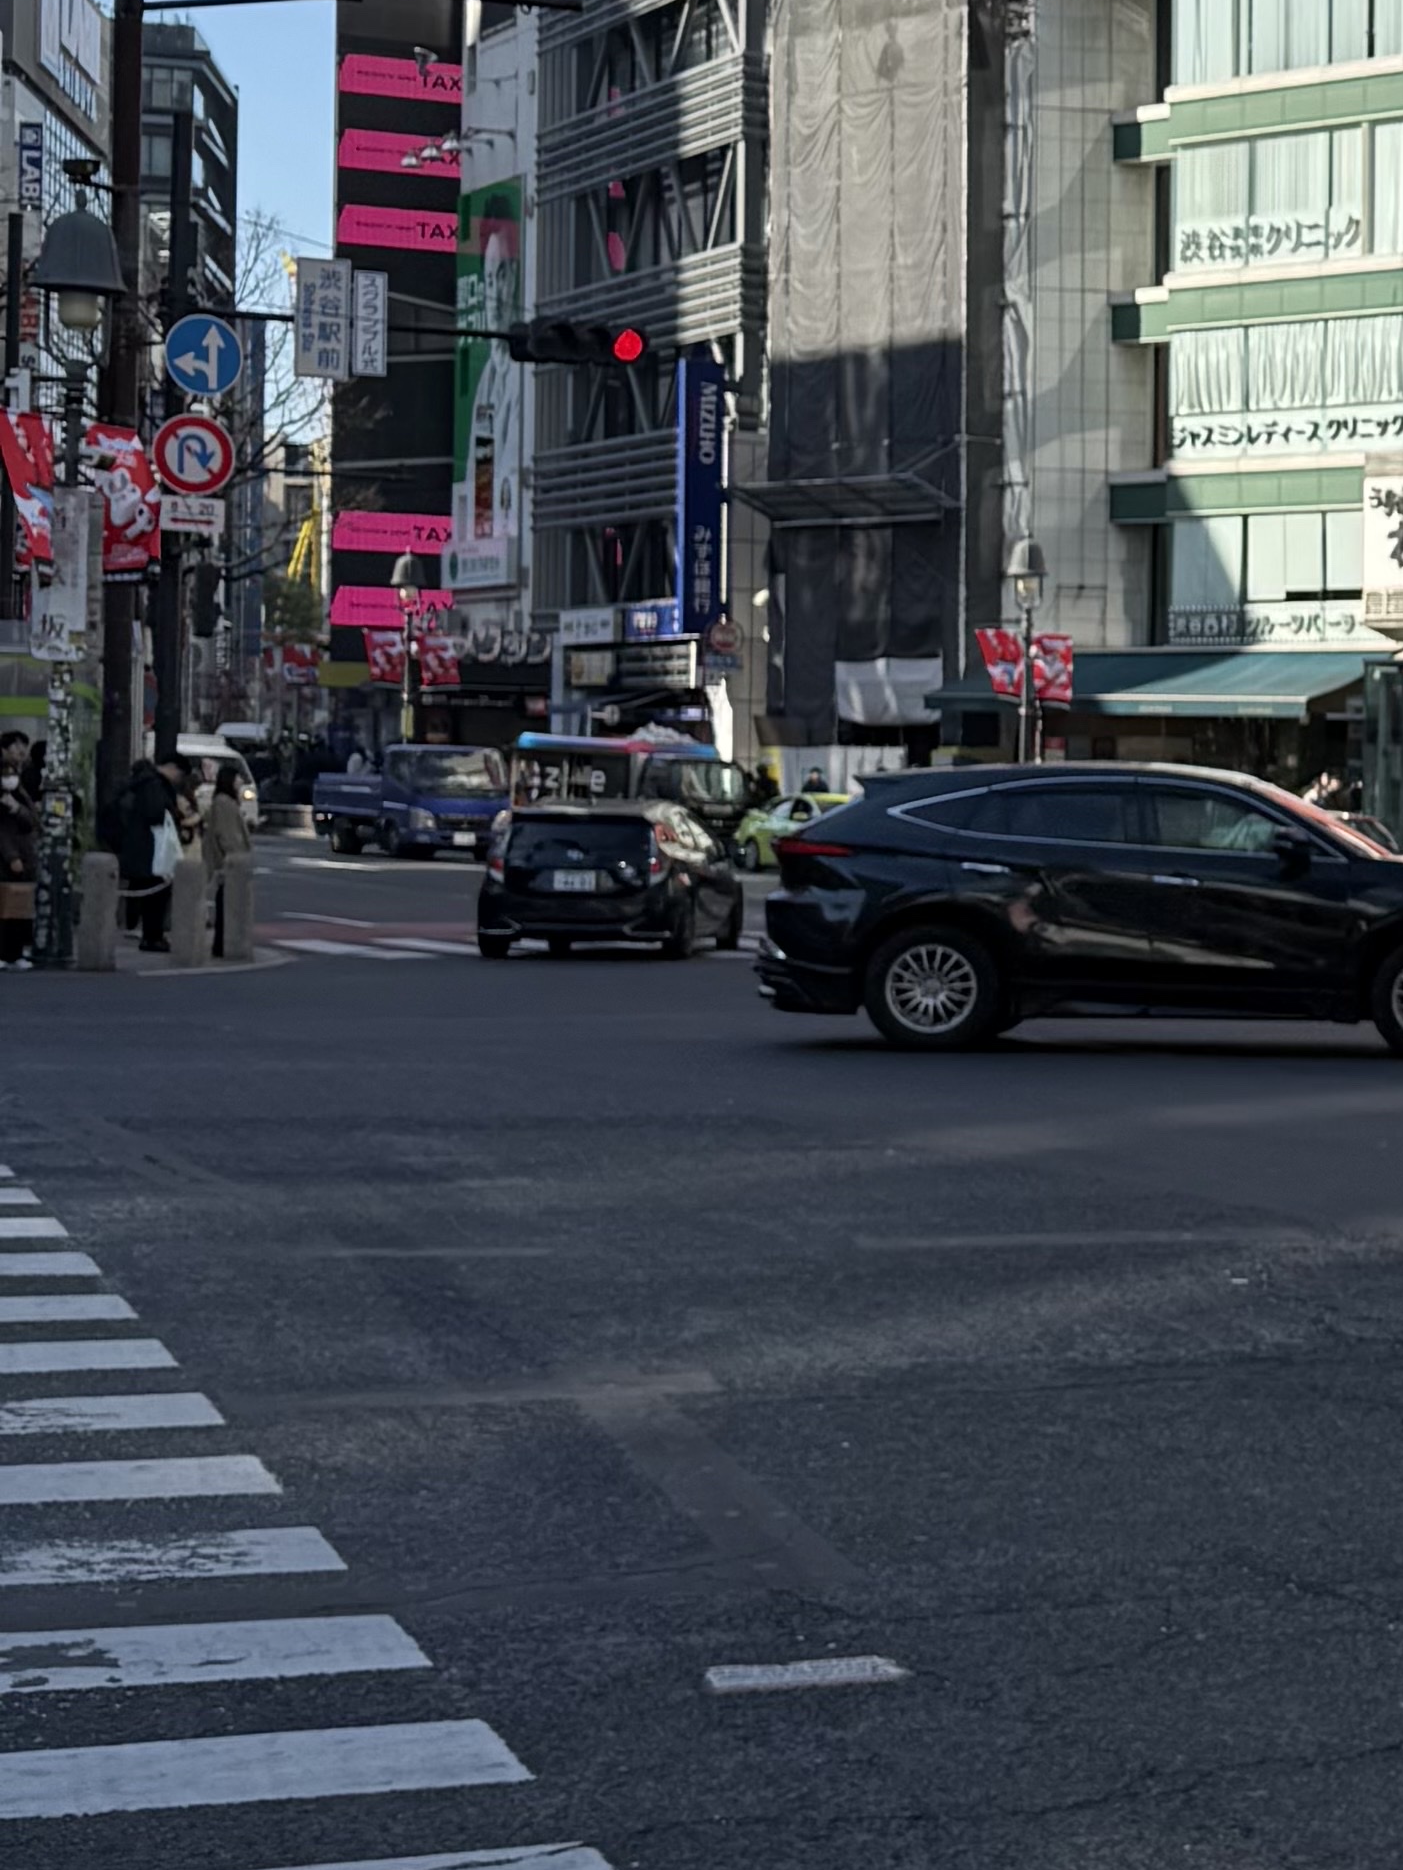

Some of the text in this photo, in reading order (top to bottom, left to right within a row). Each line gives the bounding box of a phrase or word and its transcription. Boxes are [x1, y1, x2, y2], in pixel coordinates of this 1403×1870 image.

[317, 267, 342, 371] 渋谷駅前
[700, 381, 718, 466] MIZUHO
